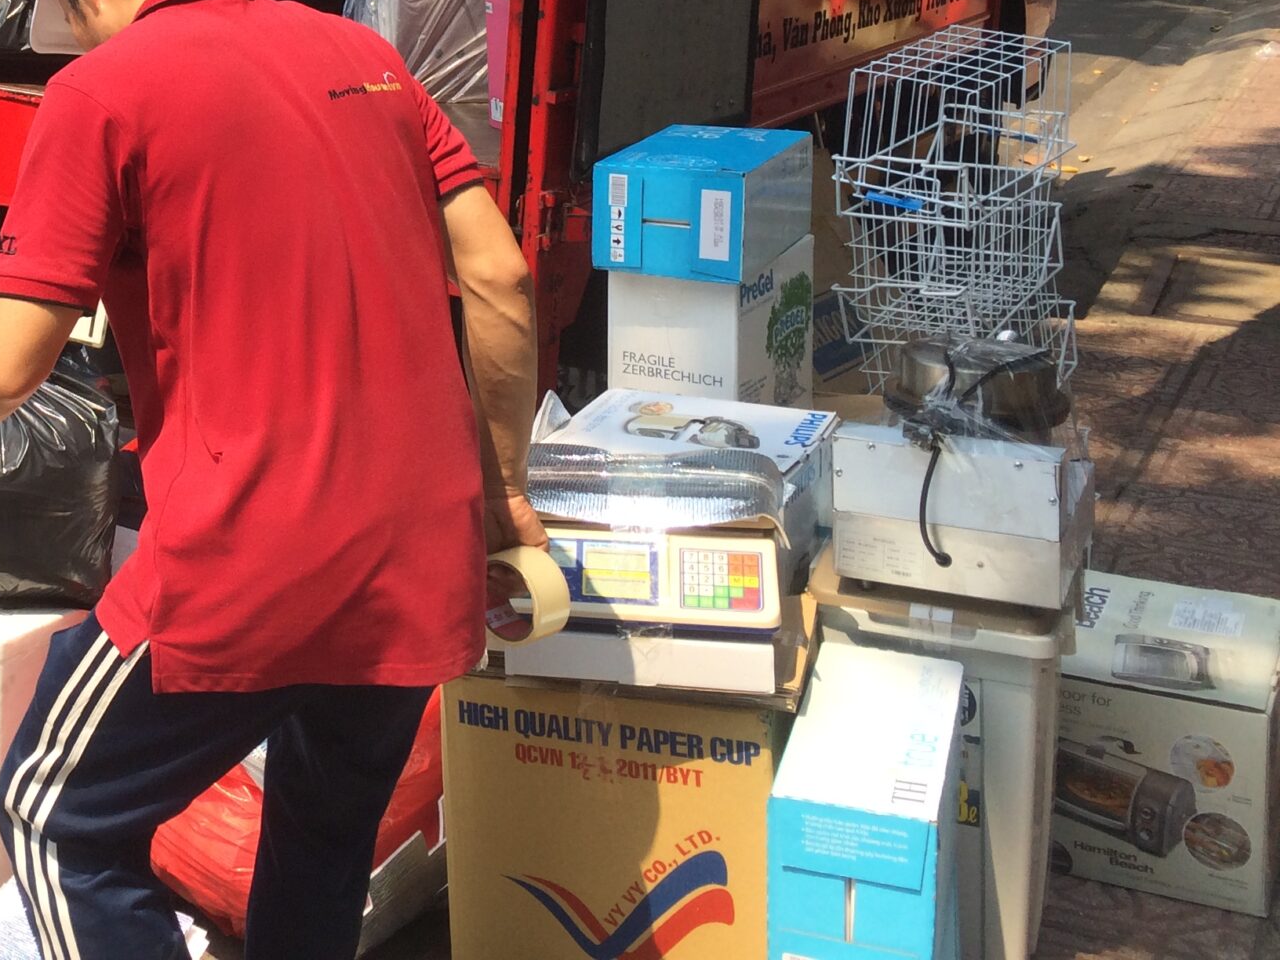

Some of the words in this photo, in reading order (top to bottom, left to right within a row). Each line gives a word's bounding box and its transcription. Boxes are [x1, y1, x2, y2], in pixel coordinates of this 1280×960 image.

[740, 268, 774, 307] PreGel
[622, 350, 676, 368] FRAGILE
[622, 362, 723, 388] ZERBRECHLICH
[784, 412, 828, 448] PHILIPS
[1091, 692, 1113, 707] for
[458, 700, 509, 732] HIGH
[514, 709, 613, 747] QUALITY
[620, 724, 704, 761] PAPER
[709, 736, 761, 767] CUP
[515, 743, 563, 768] QCVN
[1074, 840, 1137, 863] Hamilton
[1109, 855, 1155, 875] Beach
[604, 903, 626, 928] VY
[621, 881, 645, 905] VY
[643, 859, 679, 884] CO.,
[675, 829, 721, 857] LTD.
